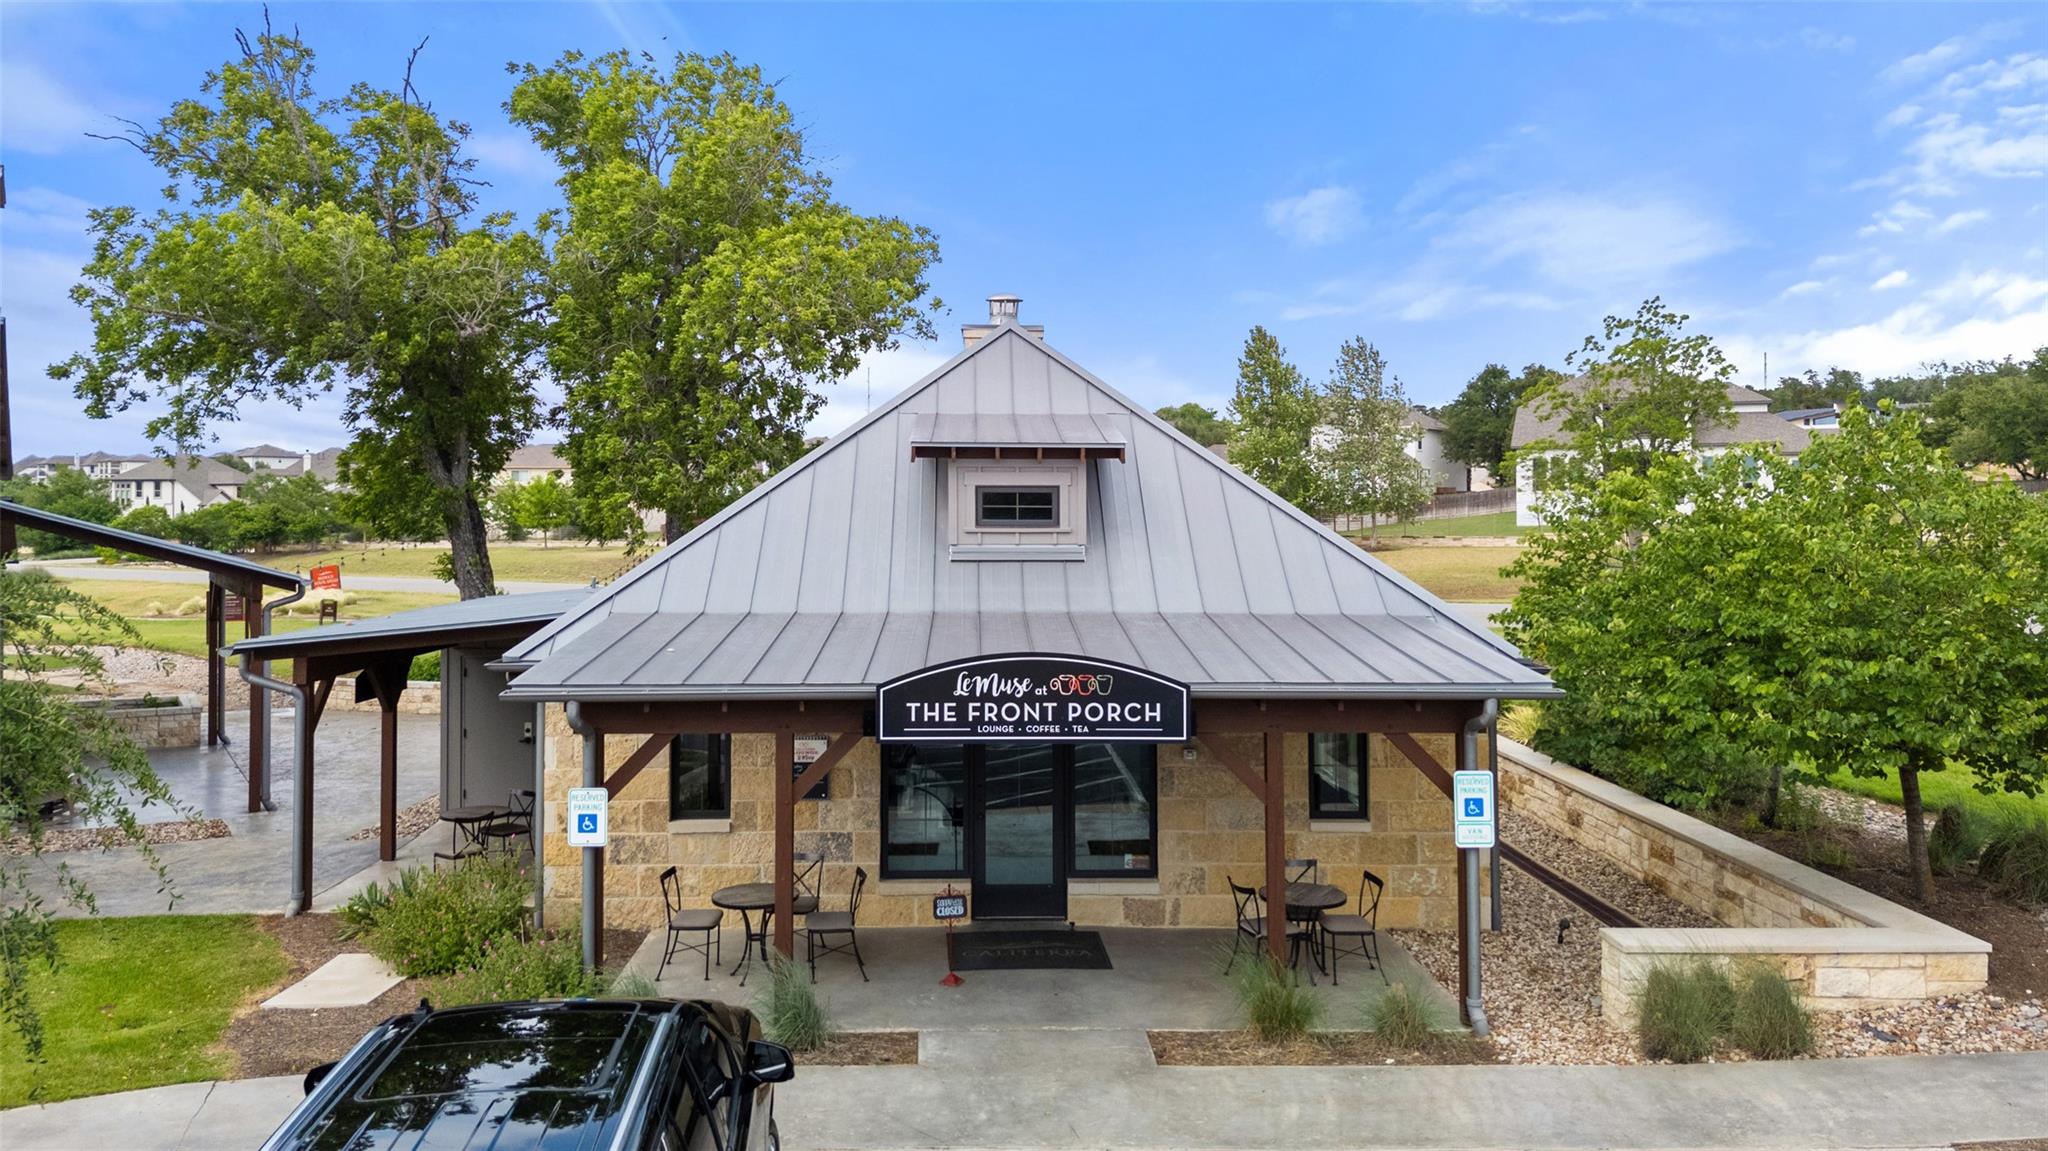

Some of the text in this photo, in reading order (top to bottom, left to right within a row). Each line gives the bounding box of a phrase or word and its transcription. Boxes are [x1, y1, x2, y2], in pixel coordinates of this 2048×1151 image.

[1034, 684, 1048, 696] at
[906, 703, 1161, 722] THE FRONT PORCH
[977, 724, 1089, 733] LOUNGE COFFEE TEA
[936, 906, 964, 916] CLOSED
